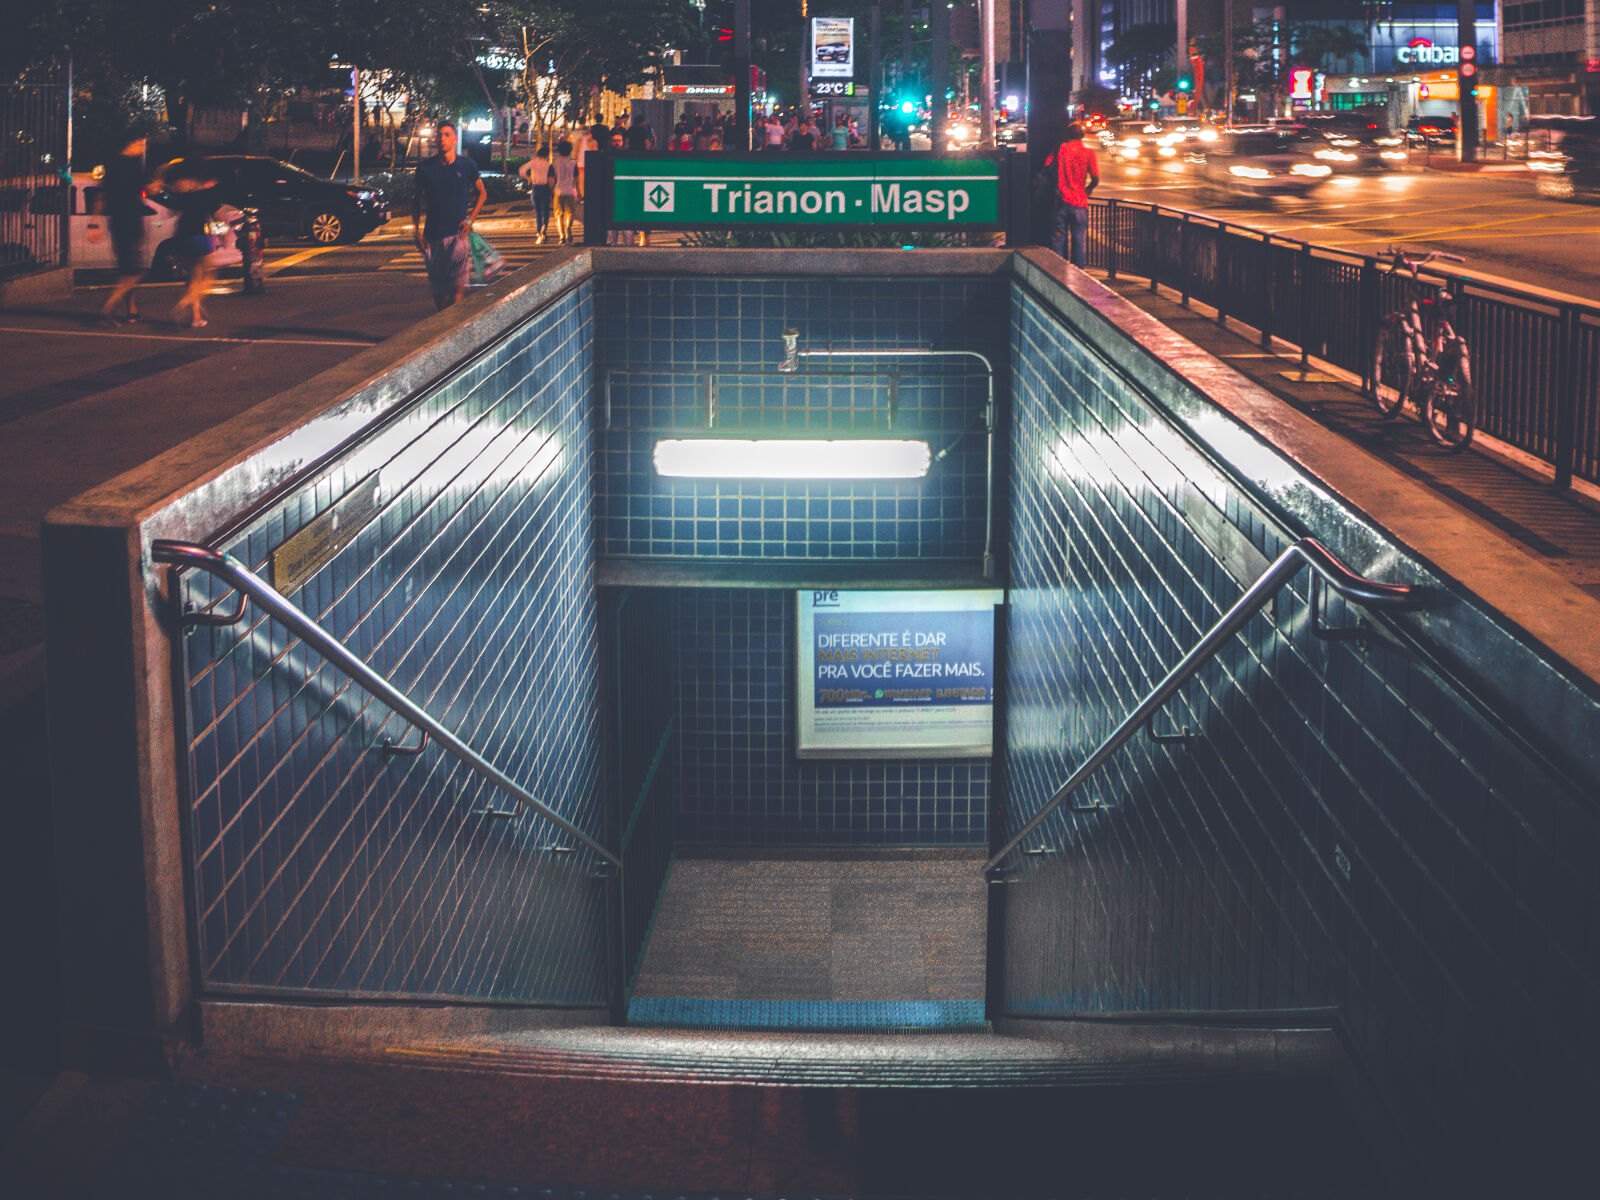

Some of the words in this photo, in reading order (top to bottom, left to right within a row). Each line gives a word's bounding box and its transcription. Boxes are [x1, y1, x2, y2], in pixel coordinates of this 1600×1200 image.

[703, 183, 846, 214] Trianon
[871, 183, 970, 220] Masp
[818, 632, 899, 648] DIFERENTE
[902, 630, 911, 646] É
[915, 631, 946, 647] DAR
[818, 649, 858, 663] MAIS
[862, 648, 940, 662] INTERNET
[818, 664, 848, 679] PRA
[851, 661, 892, 679] VOCÊ
[895, 663, 942, 678] FAZER
[945, 662, 985, 677] MAIS.
